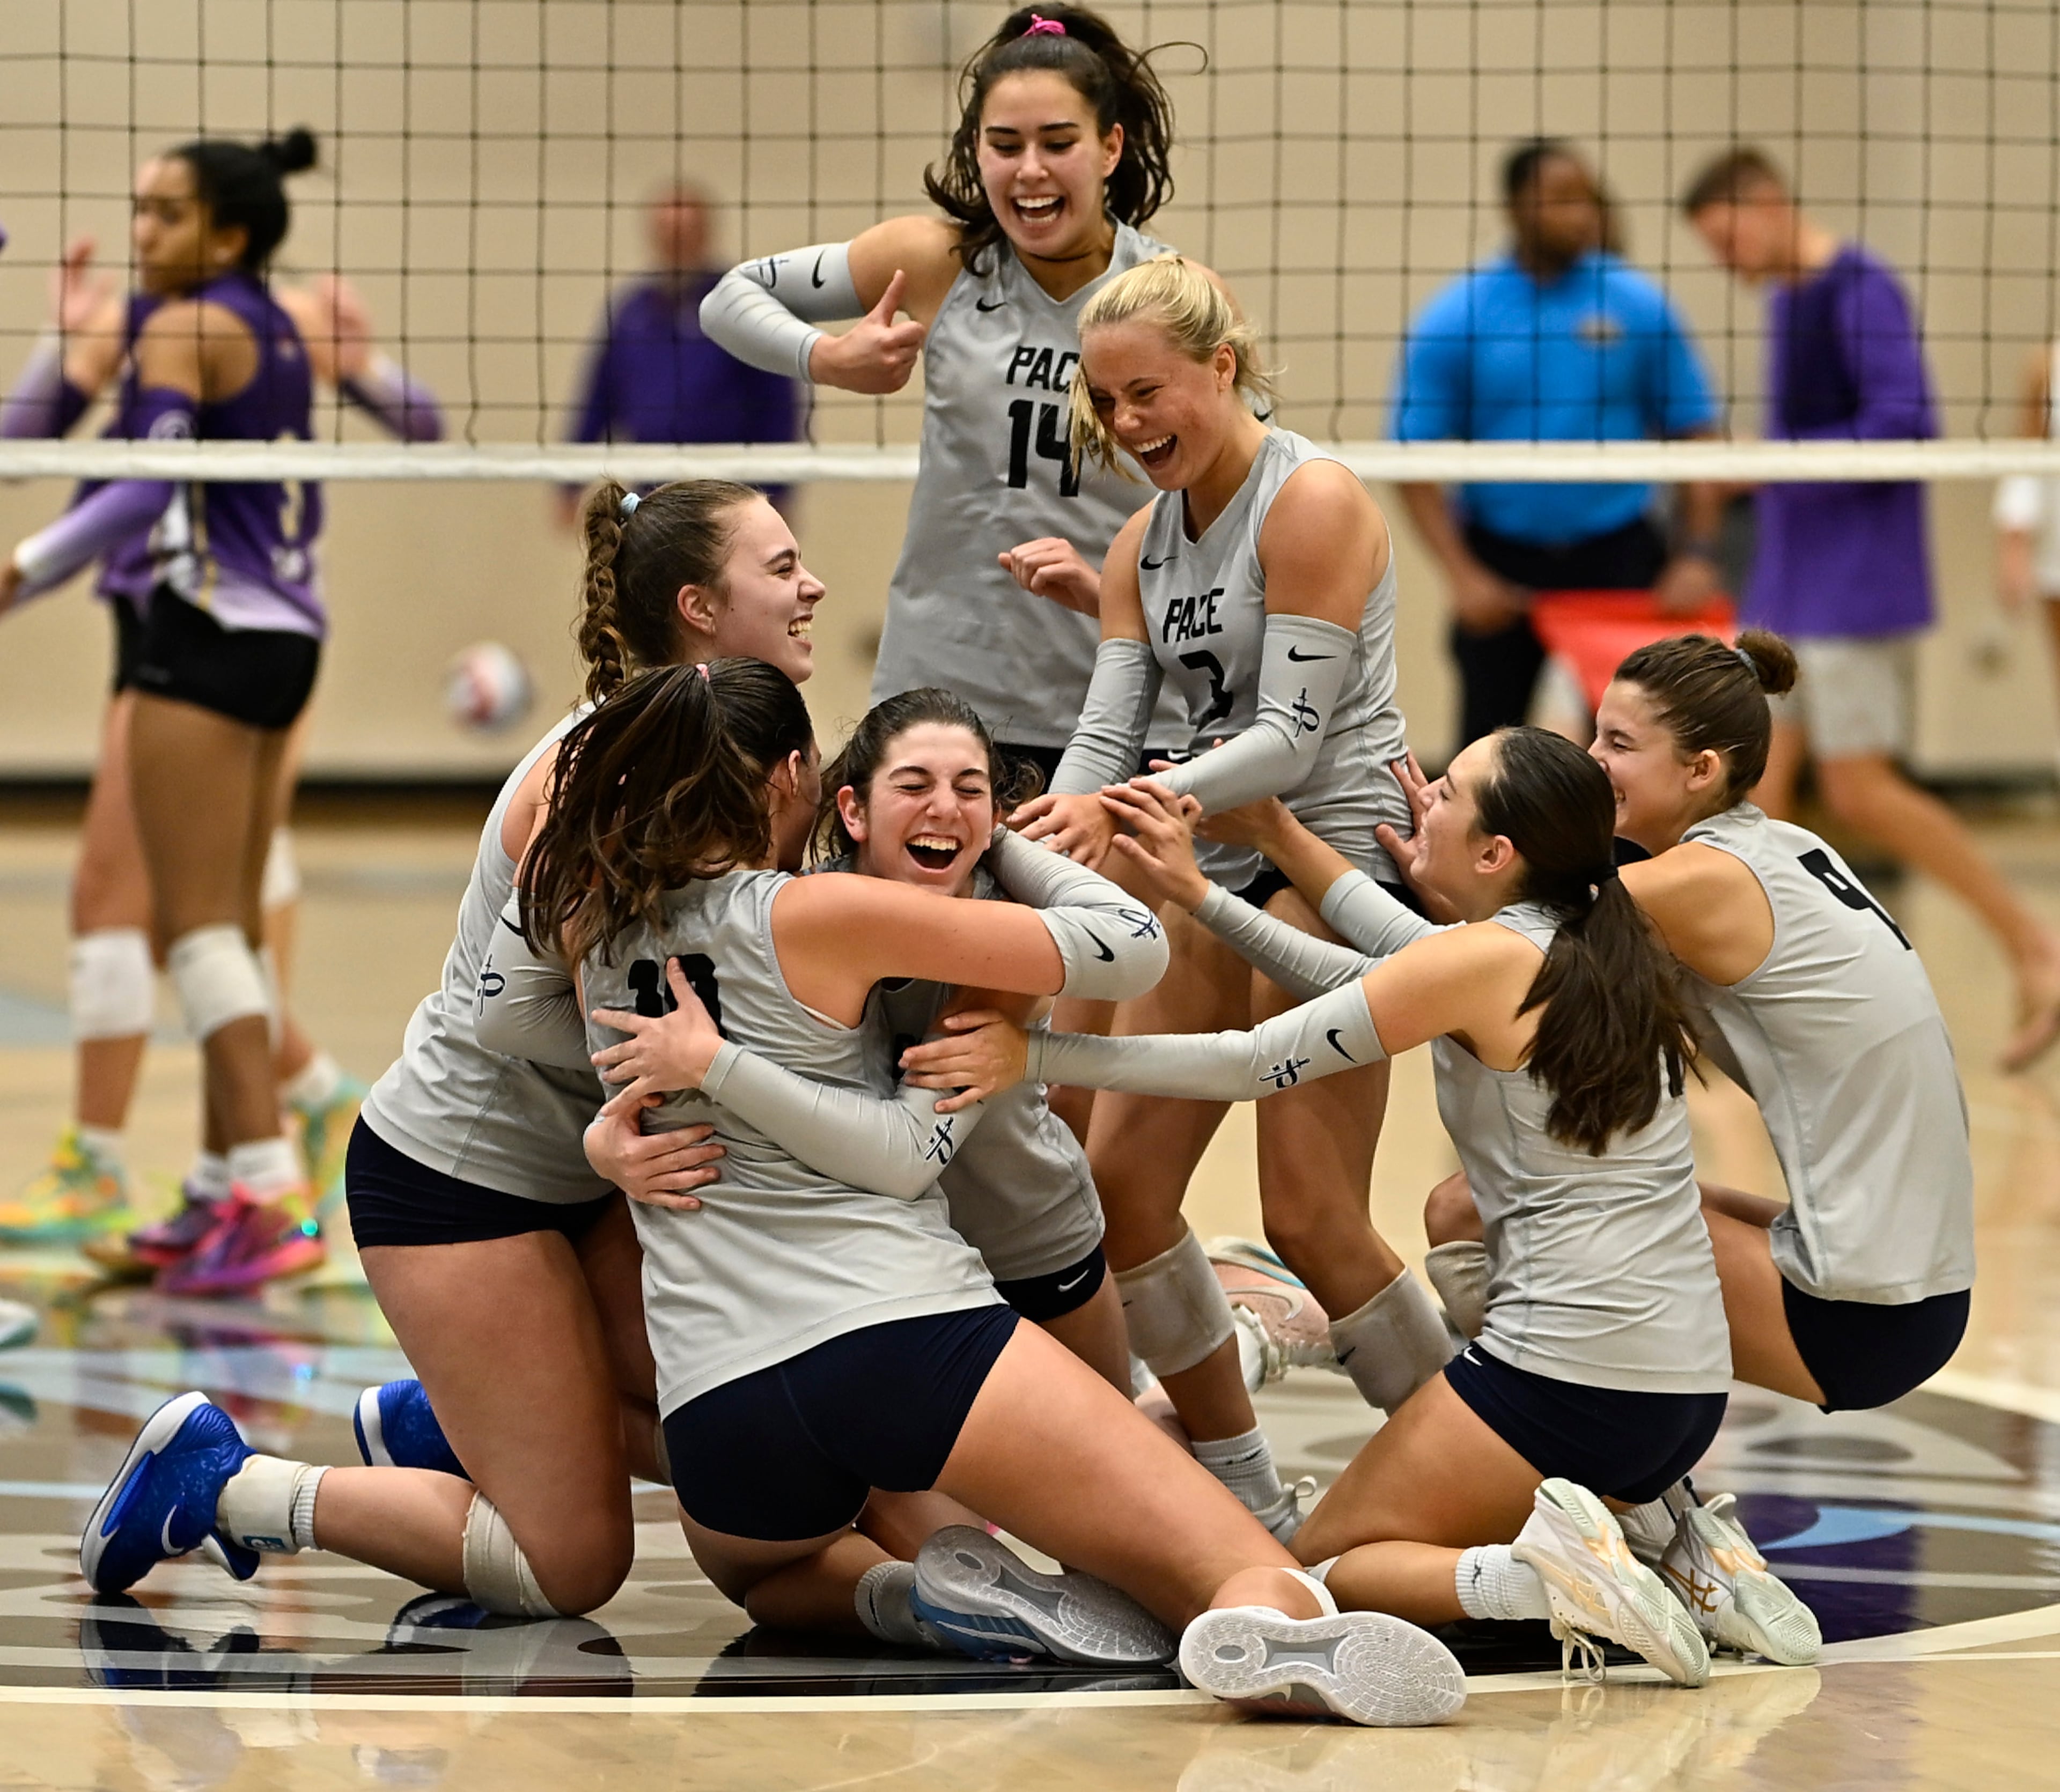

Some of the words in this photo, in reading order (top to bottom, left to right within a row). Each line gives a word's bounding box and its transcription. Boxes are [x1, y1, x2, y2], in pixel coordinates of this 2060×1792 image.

[1006, 345, 1080, 394] PAC
[1007, 399, 1083, 497] 14
[1796, 848, 1912, 950] 9
